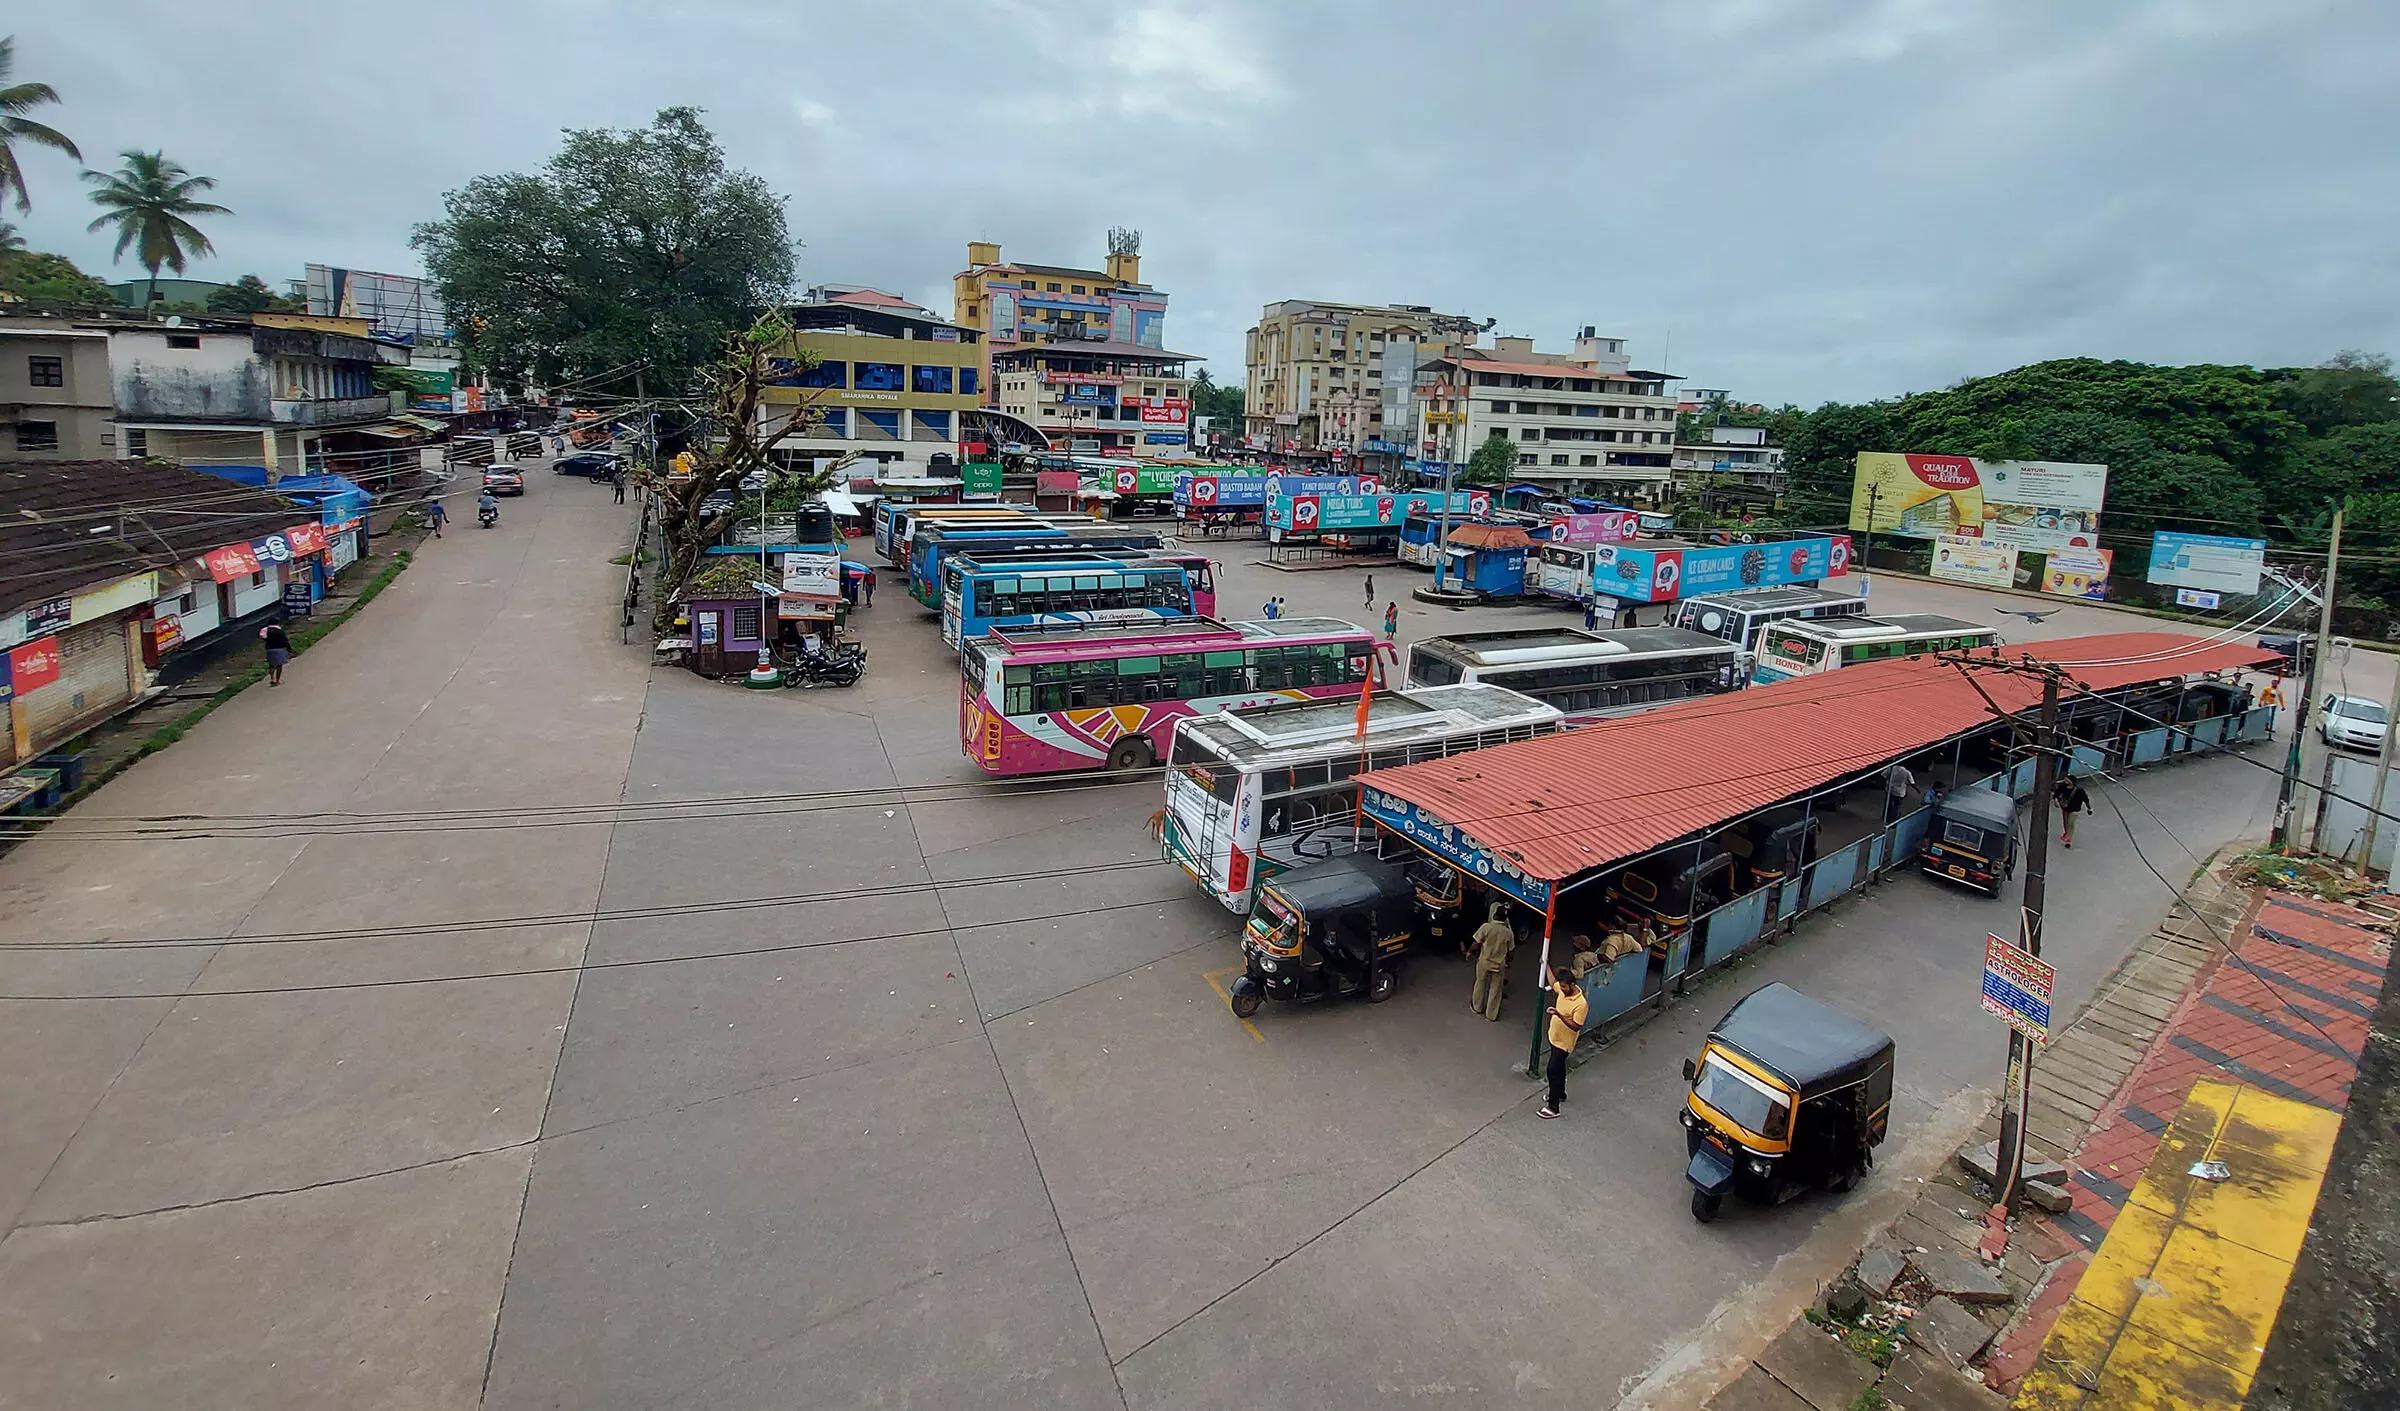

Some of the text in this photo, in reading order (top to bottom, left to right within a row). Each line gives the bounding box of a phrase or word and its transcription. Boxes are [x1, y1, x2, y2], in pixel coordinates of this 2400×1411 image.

[841, 392, 875, 400] SMARANIKA
[1922, 463, 1961, 473] QUALITY
[1928, 474, 1971, 484] TRADITION
[1220, 483, 1262, 492] ROASTED BADAM
[1697, 558, 1717, 574] CREAM
[28, 600, 71, 621] STOP & SEE
[1775, 658, 1805, 673] HONEY
[1417, 828, 1439, 845] ಉಡುಪಿ
[1440, 841, 1458, 855] ನಗರ
[1987, 959, 2050, 999] ASTROLOGER
